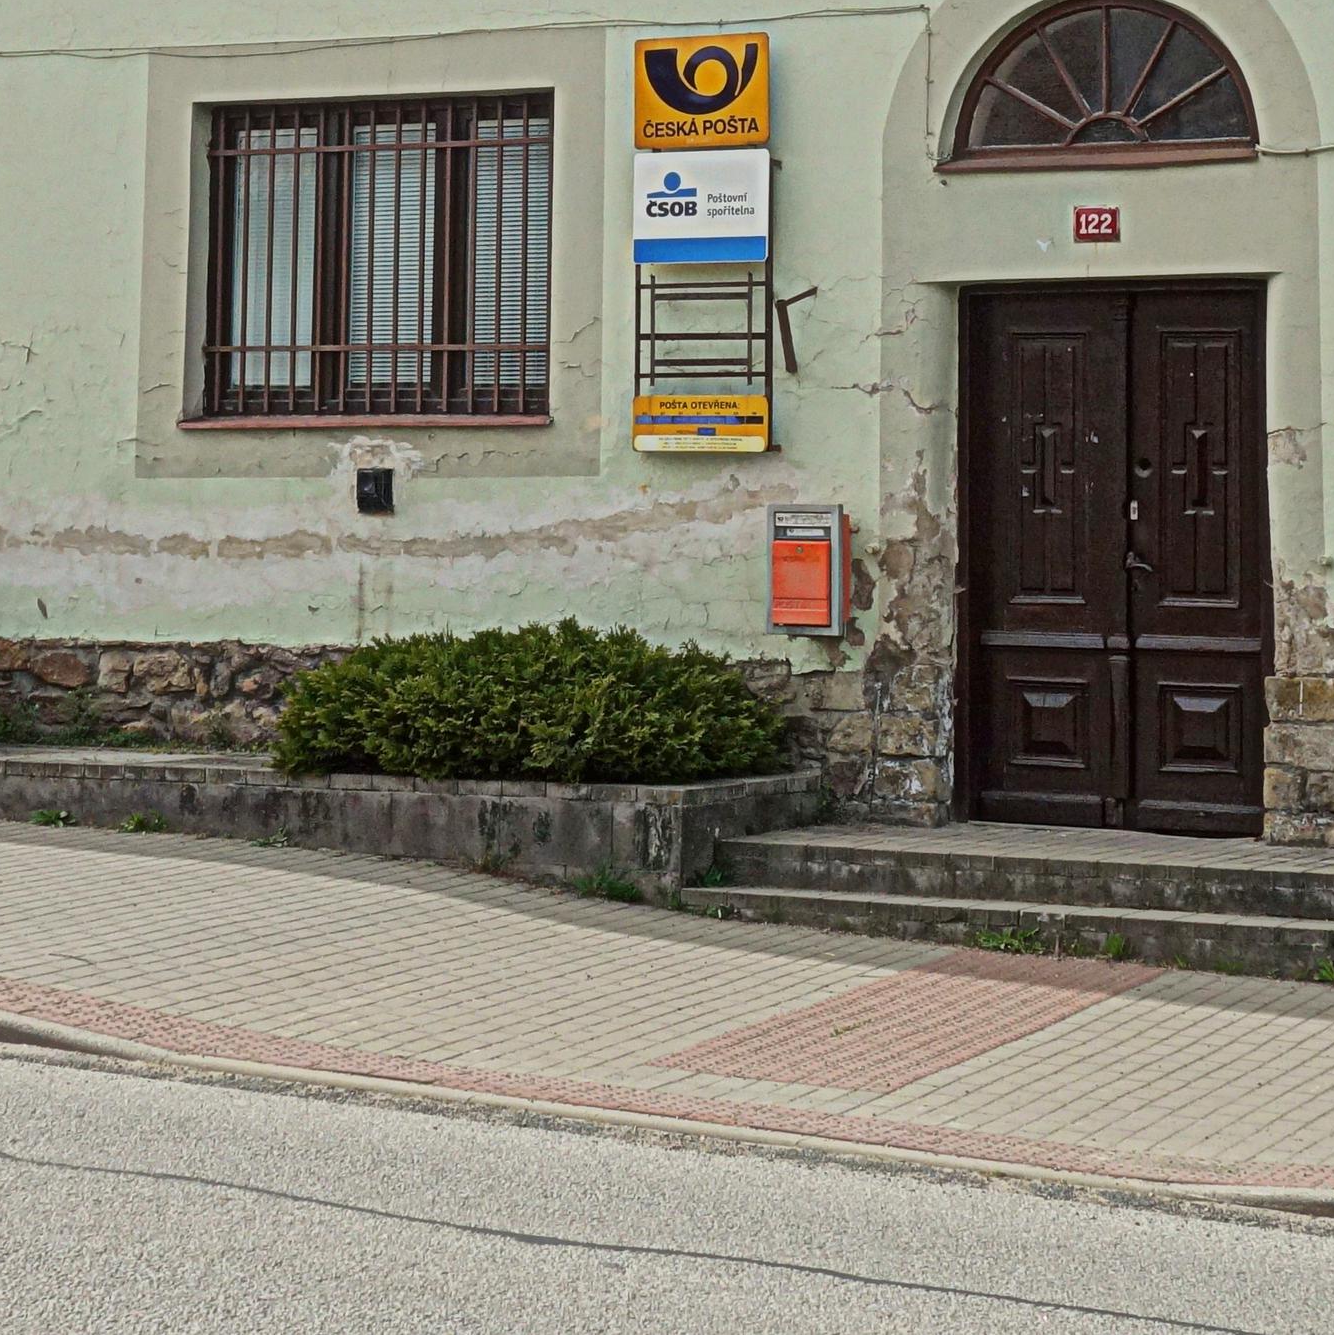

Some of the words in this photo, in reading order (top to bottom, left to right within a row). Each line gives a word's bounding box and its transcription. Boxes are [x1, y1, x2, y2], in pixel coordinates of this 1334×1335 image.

[643, 118, 699, 138] ČESKÁ
[703, 115, 759, 135] POŠTA
[707, 192, 747, 203] Poštovní
[646, 200, 698, 217] ČSOB
[707, 206, 755, 218] spořitelna
[1079, 213, 1112, 234] 122
[659, 400, 688, 410] POŠTA
